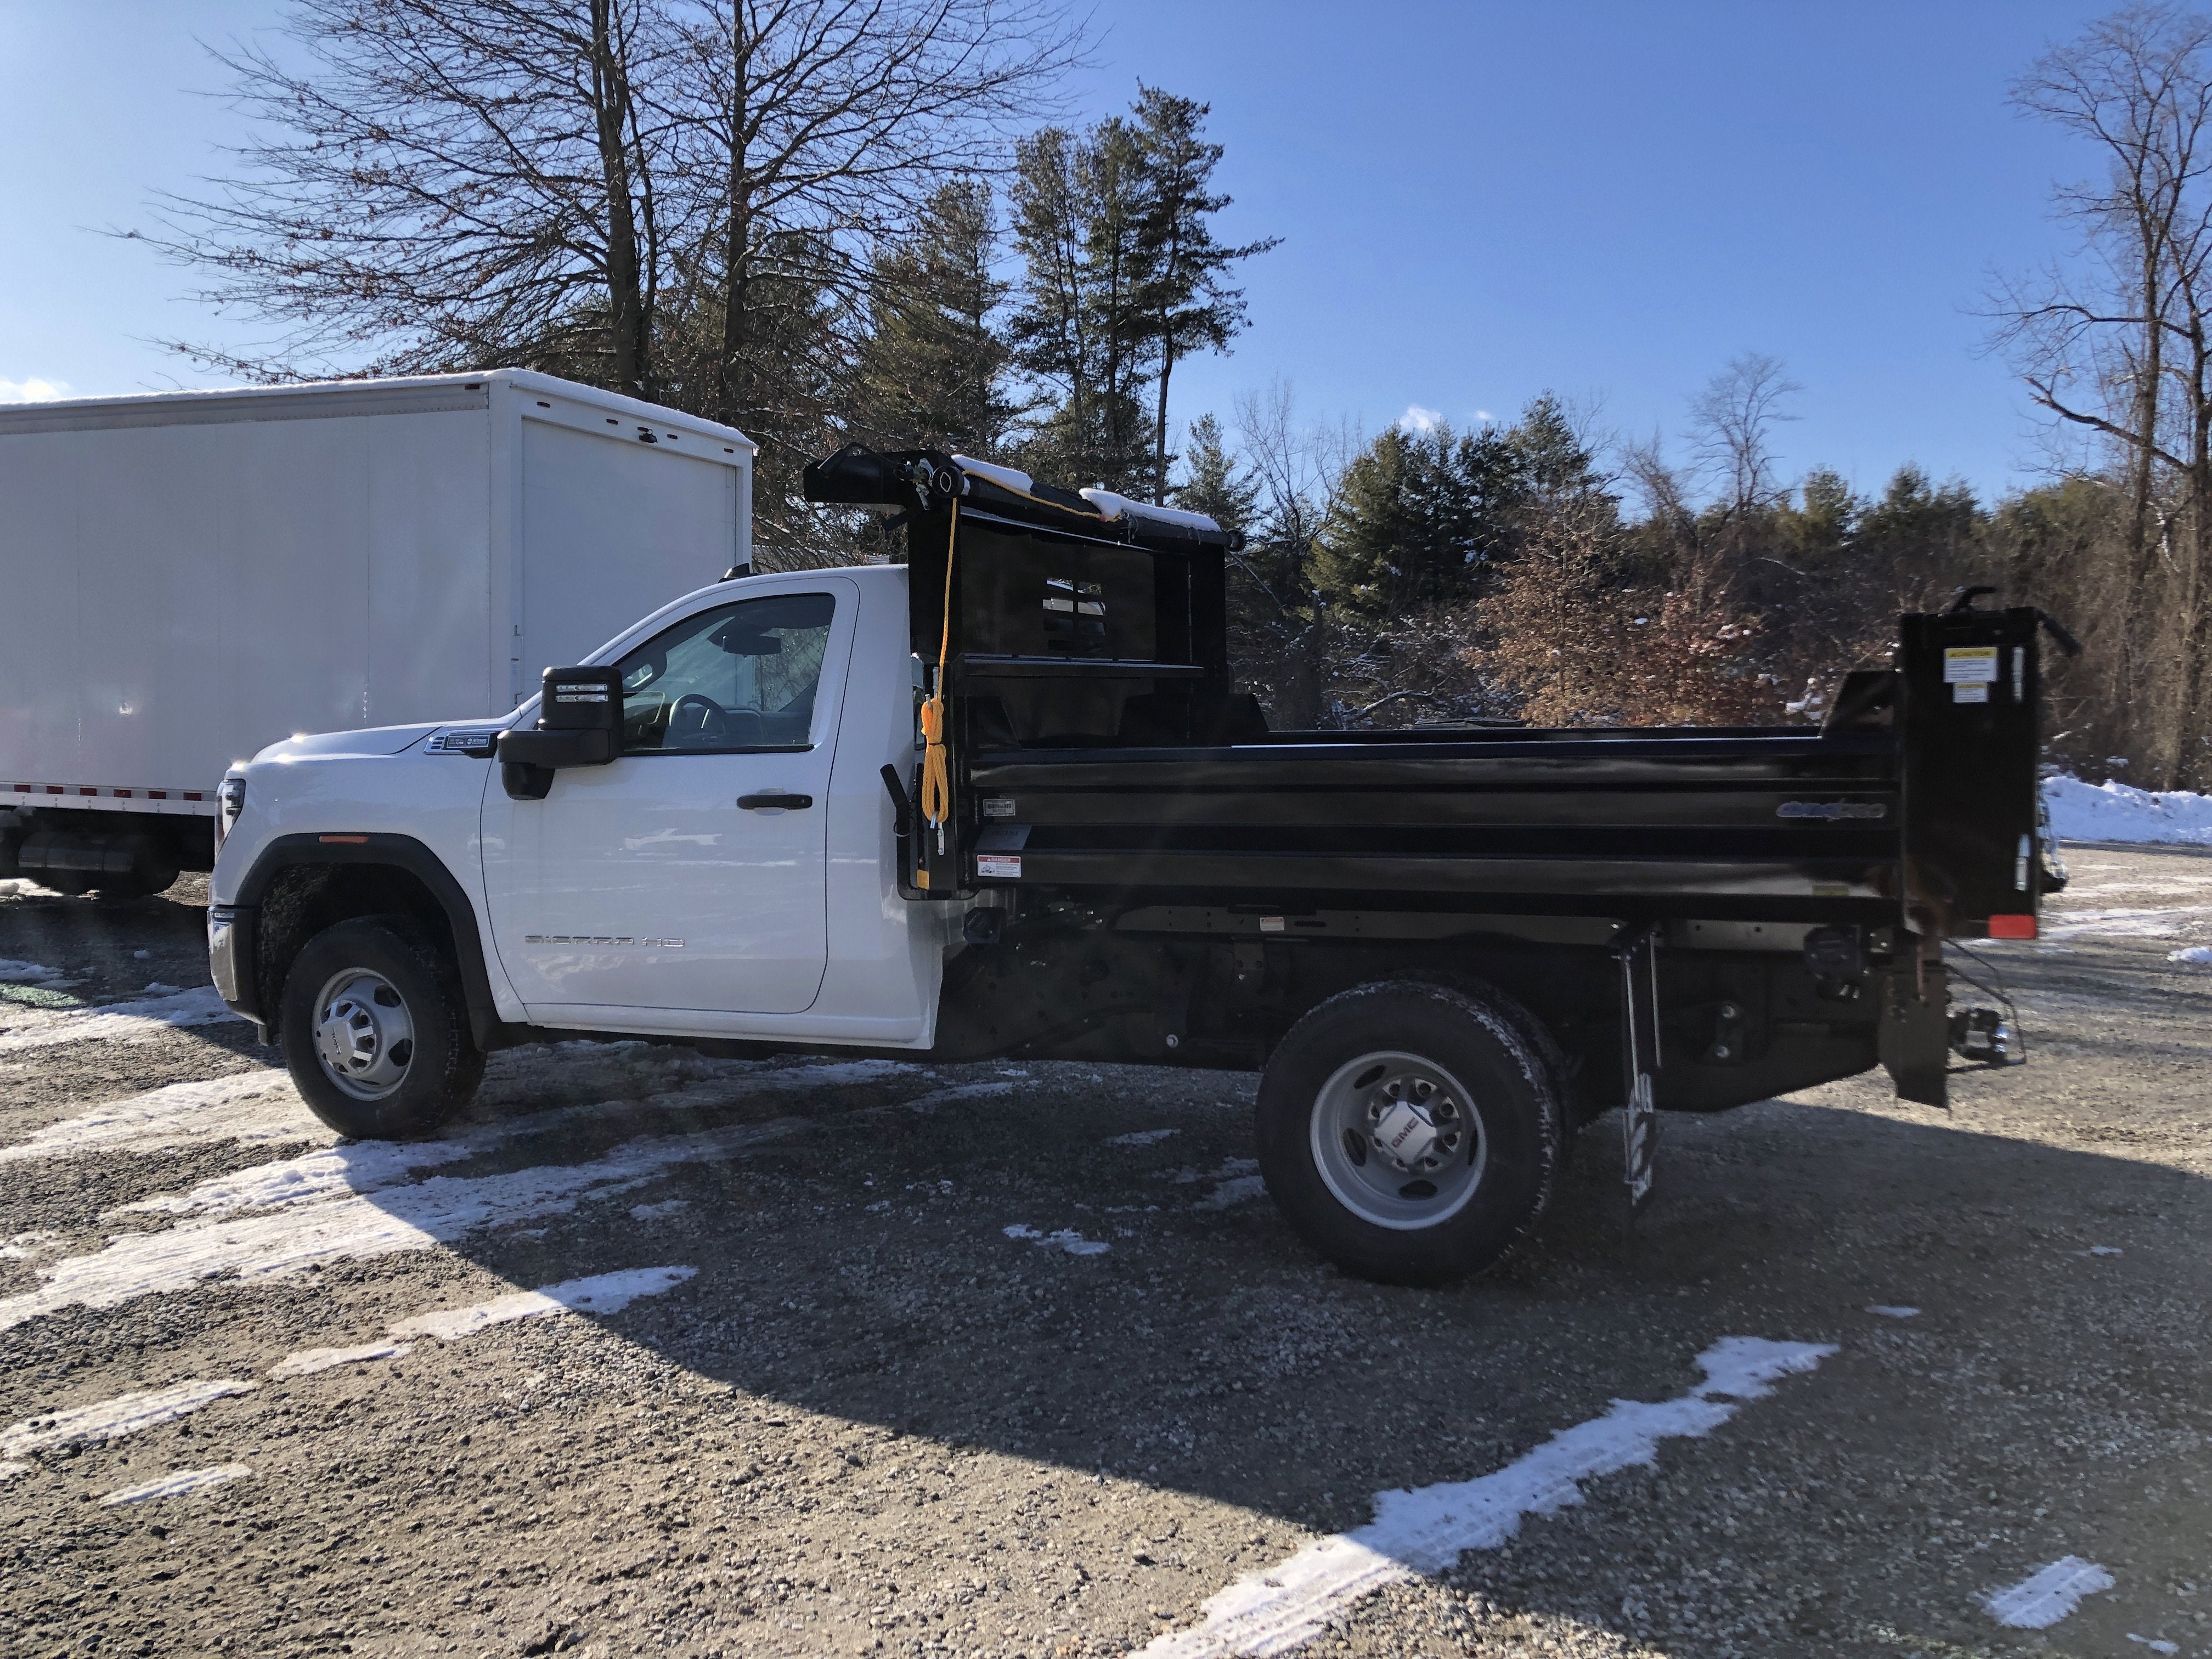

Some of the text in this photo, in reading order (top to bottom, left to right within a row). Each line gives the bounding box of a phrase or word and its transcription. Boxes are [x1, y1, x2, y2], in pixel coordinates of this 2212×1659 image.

[525, 935, 685, 947] SIERRA HD
[1391, 1116, 1420, 1148] GMC
